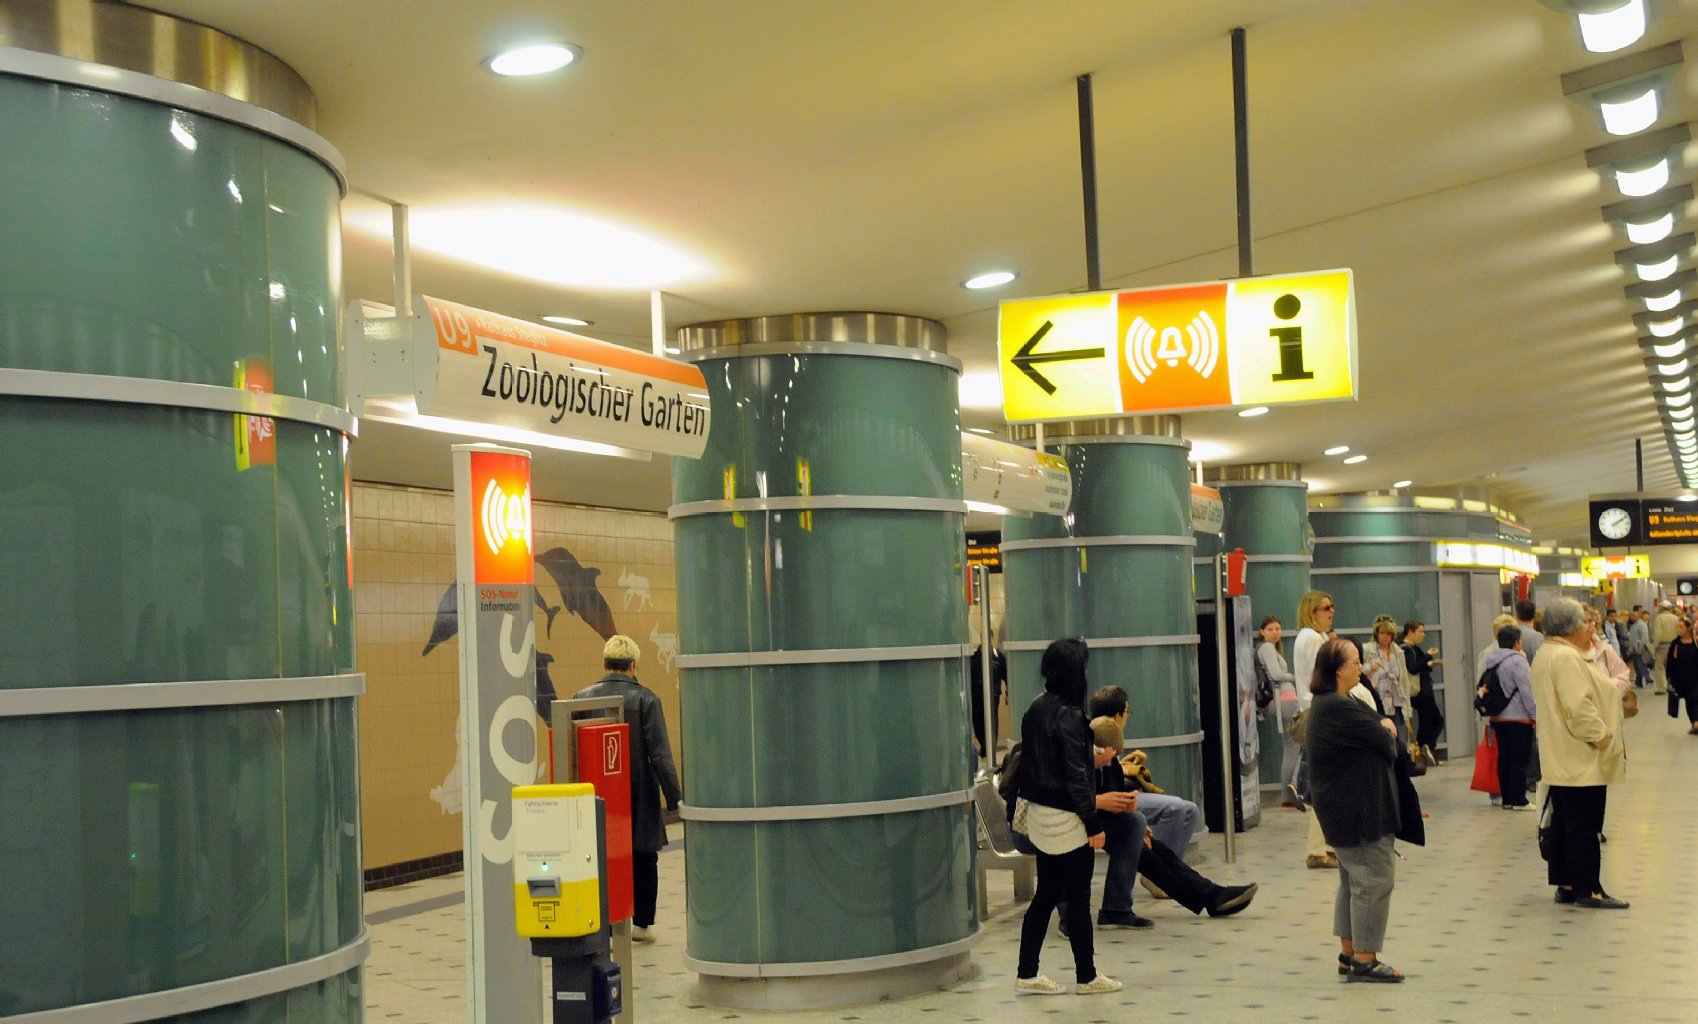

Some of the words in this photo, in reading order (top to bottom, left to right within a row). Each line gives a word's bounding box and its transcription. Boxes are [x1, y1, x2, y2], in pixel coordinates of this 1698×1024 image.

[433, 306, 472, 348] U9
[482, 345, 634, 424] Zoologischer
[641, 381, 706, 437] Garten
[480, 601, 521, 612] Information
